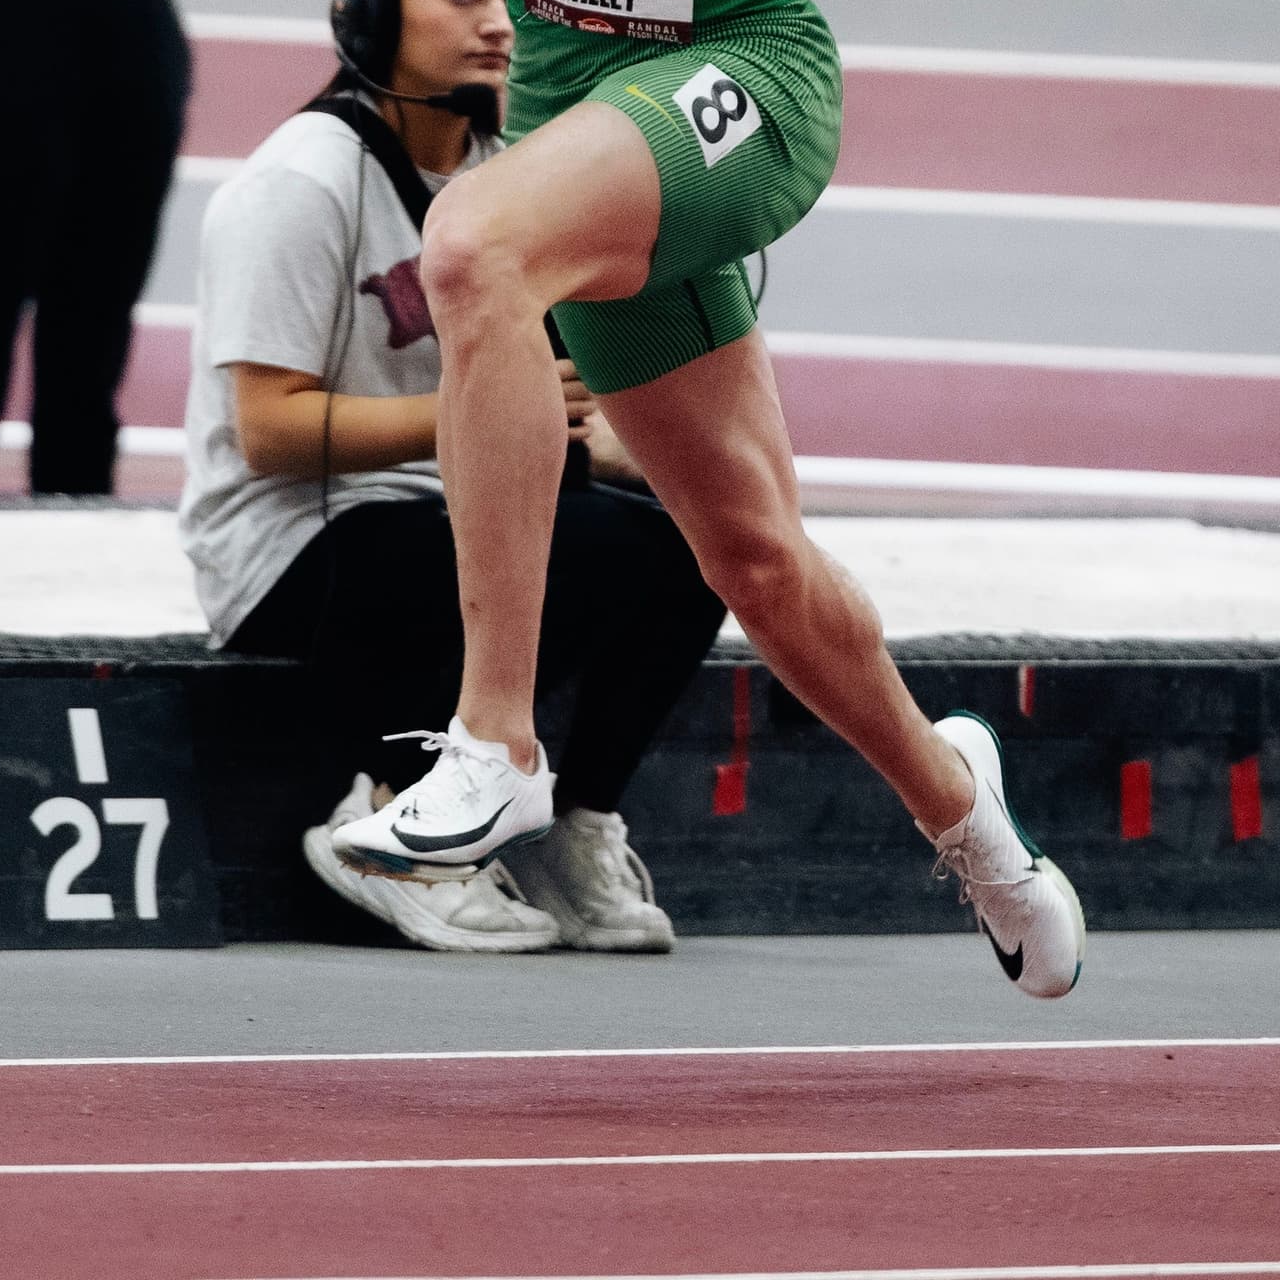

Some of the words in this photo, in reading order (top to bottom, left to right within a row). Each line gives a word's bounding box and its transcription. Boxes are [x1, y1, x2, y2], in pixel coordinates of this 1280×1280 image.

[536, 0, 565, 17] TRACK
[628, 21, 677, 35] RANDAL
[691, 78, 748, 144] 8
[29, 797, 169, 921] 27
